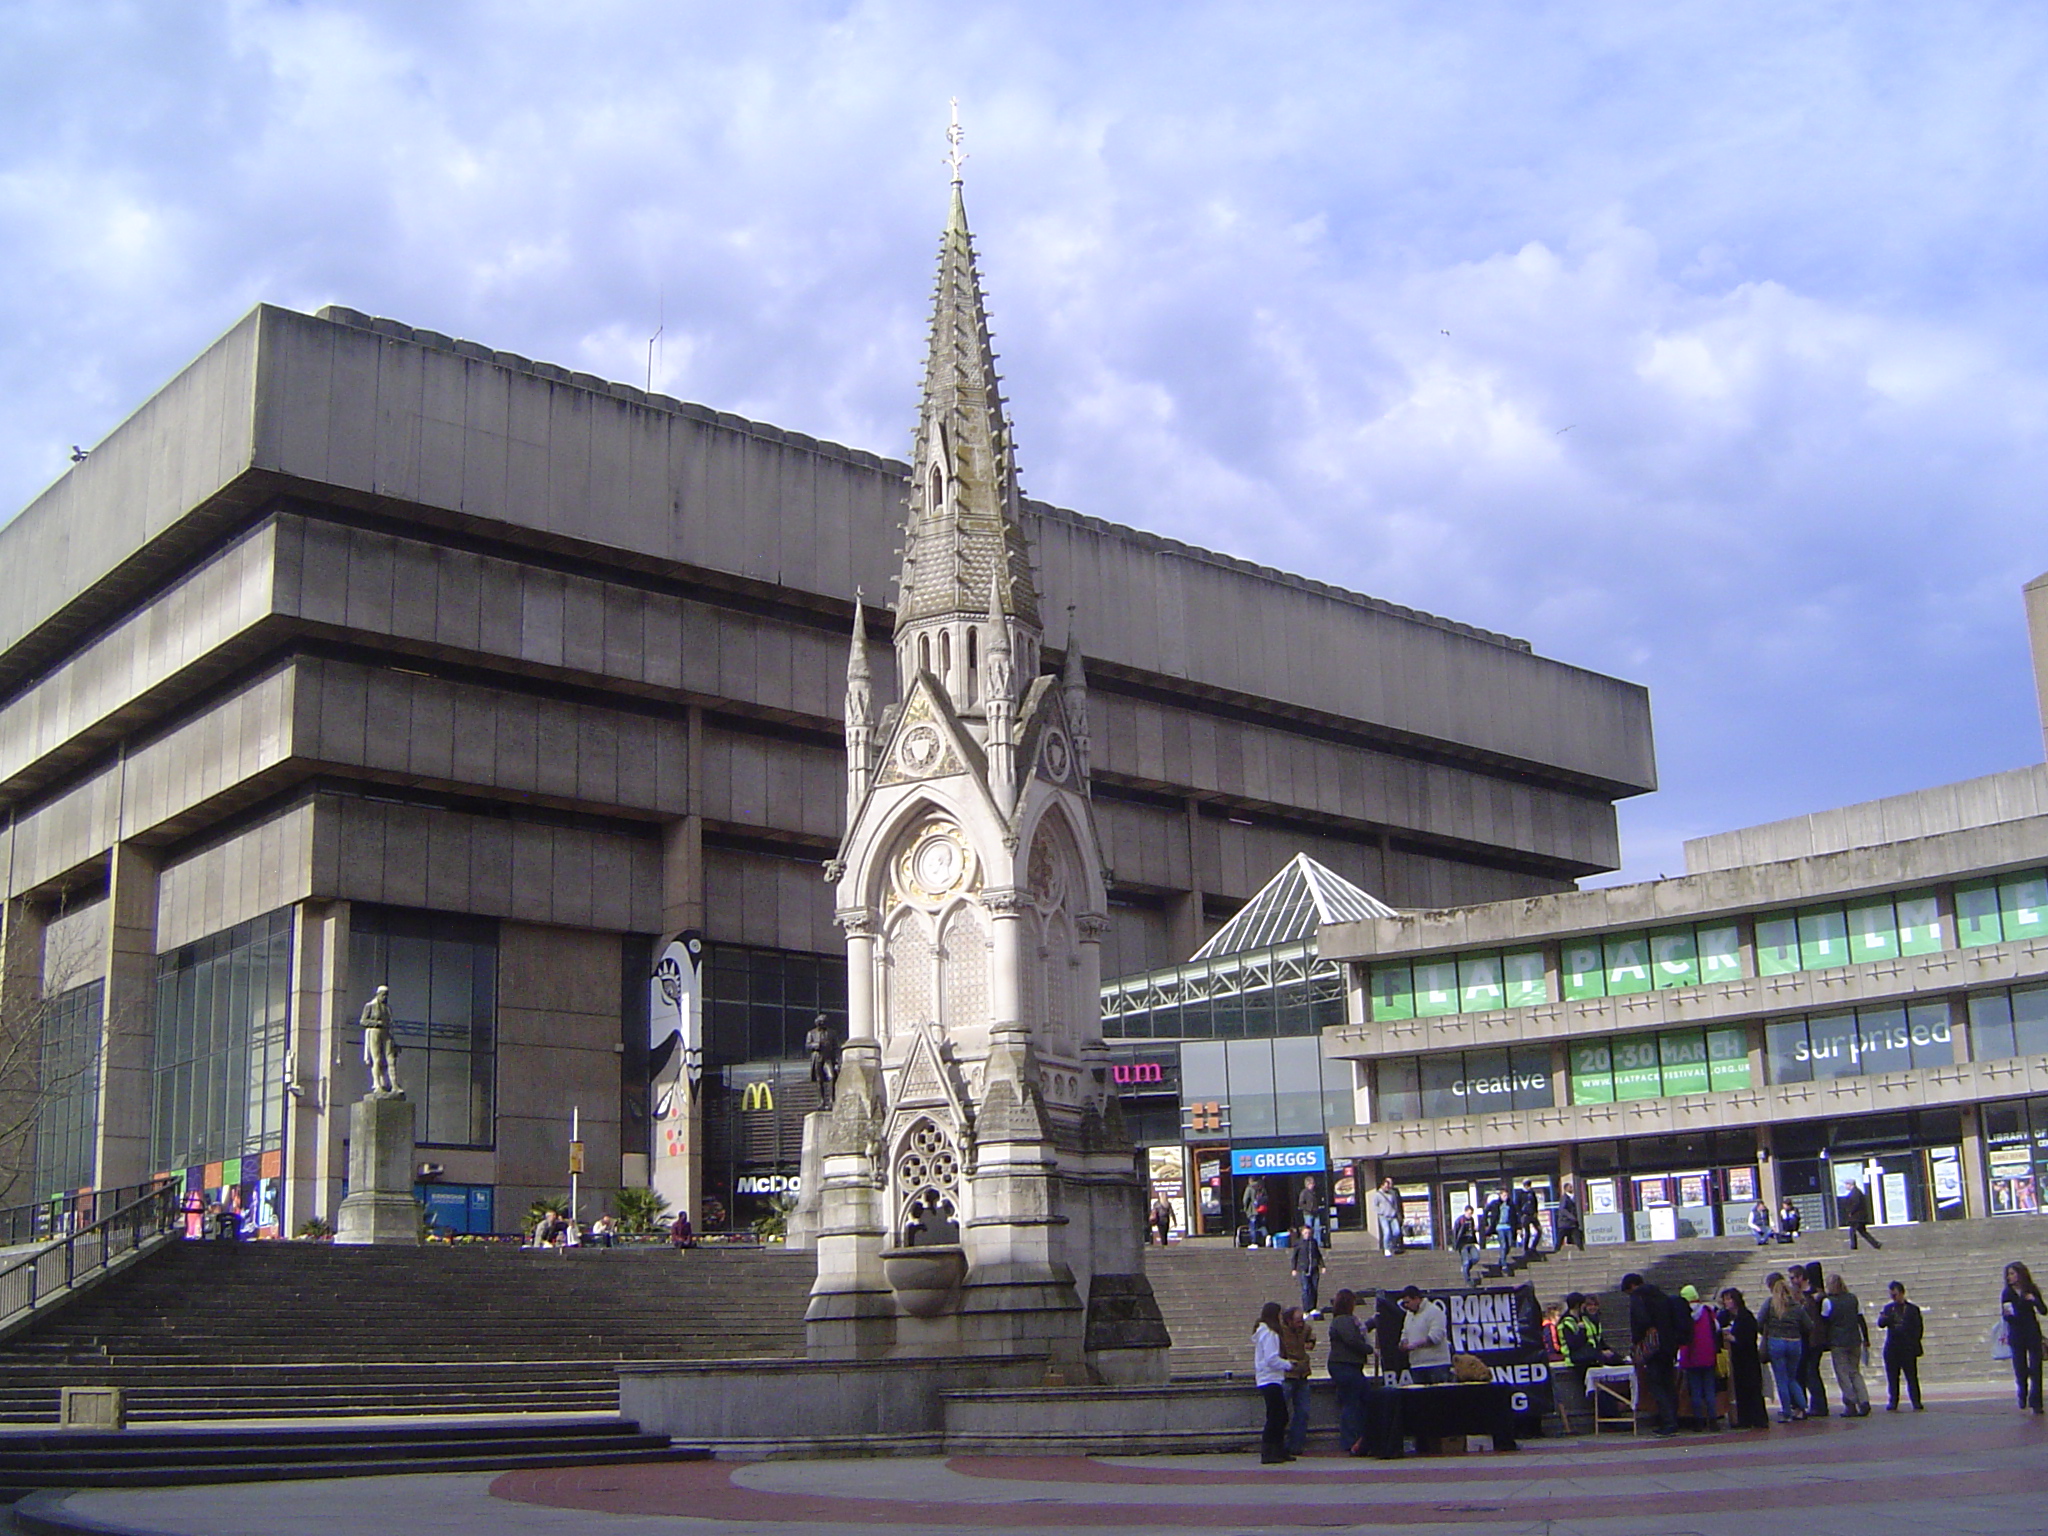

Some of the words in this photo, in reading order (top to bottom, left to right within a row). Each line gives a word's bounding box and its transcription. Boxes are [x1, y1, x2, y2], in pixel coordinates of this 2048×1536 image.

[1383, 955, 1536, 1007] FLAT
[1571, 926, 1737, 987] PACK
[1662, 1038, 1740, 1064] MARCH
[1794, 1012, 1951, 1064] surprised
[1112, 1063, 1163, 1084] um
[1452, 1069, 1546, 1096] creative
[1255, 1151, 1317, 1168] GREGGS
[1586, 1226, 1613, 1235] Central
[1592, 1234, 1618, 1243] Library
[1451, 1293, 1511, 1324] BORN
[1452, 1322, 1516, 1352] FREE
